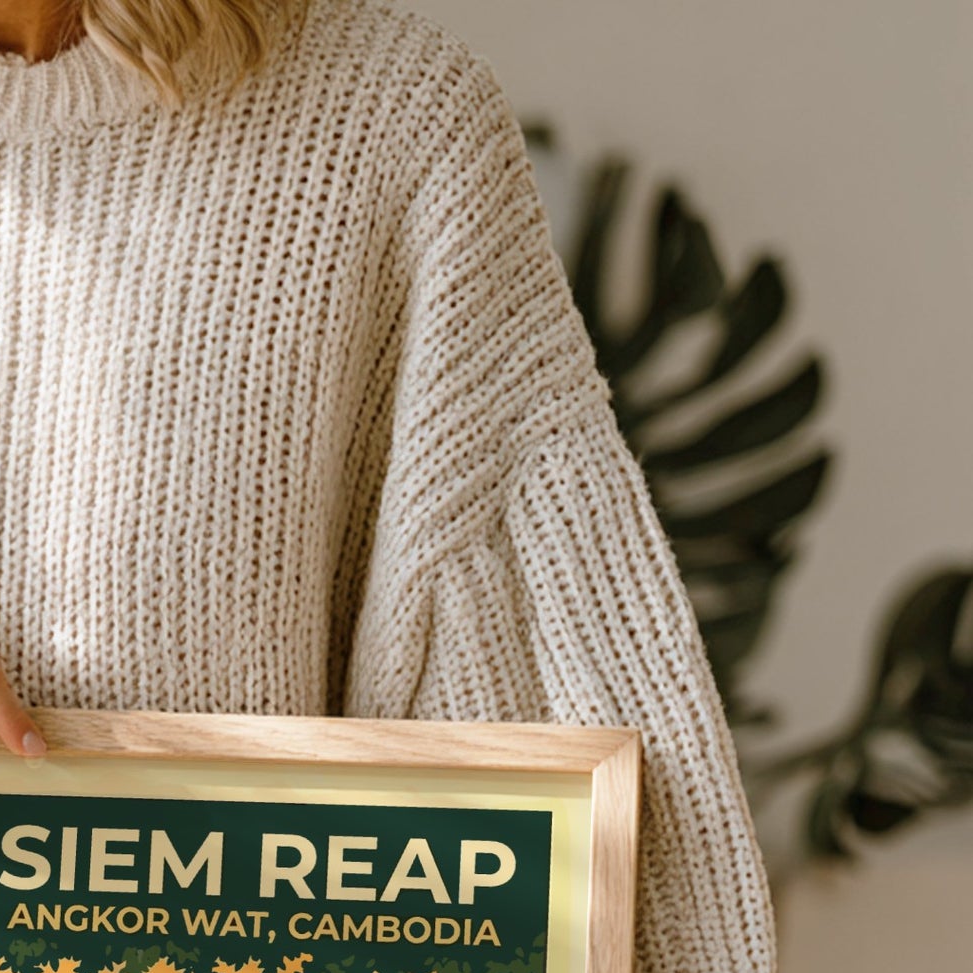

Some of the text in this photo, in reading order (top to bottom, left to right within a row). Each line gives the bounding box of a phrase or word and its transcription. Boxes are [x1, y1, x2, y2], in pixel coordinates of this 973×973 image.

[259, 832, 516, 905] REAP
[7, 903, 501, 947] ANGKOR WAT, CAMBODIA
